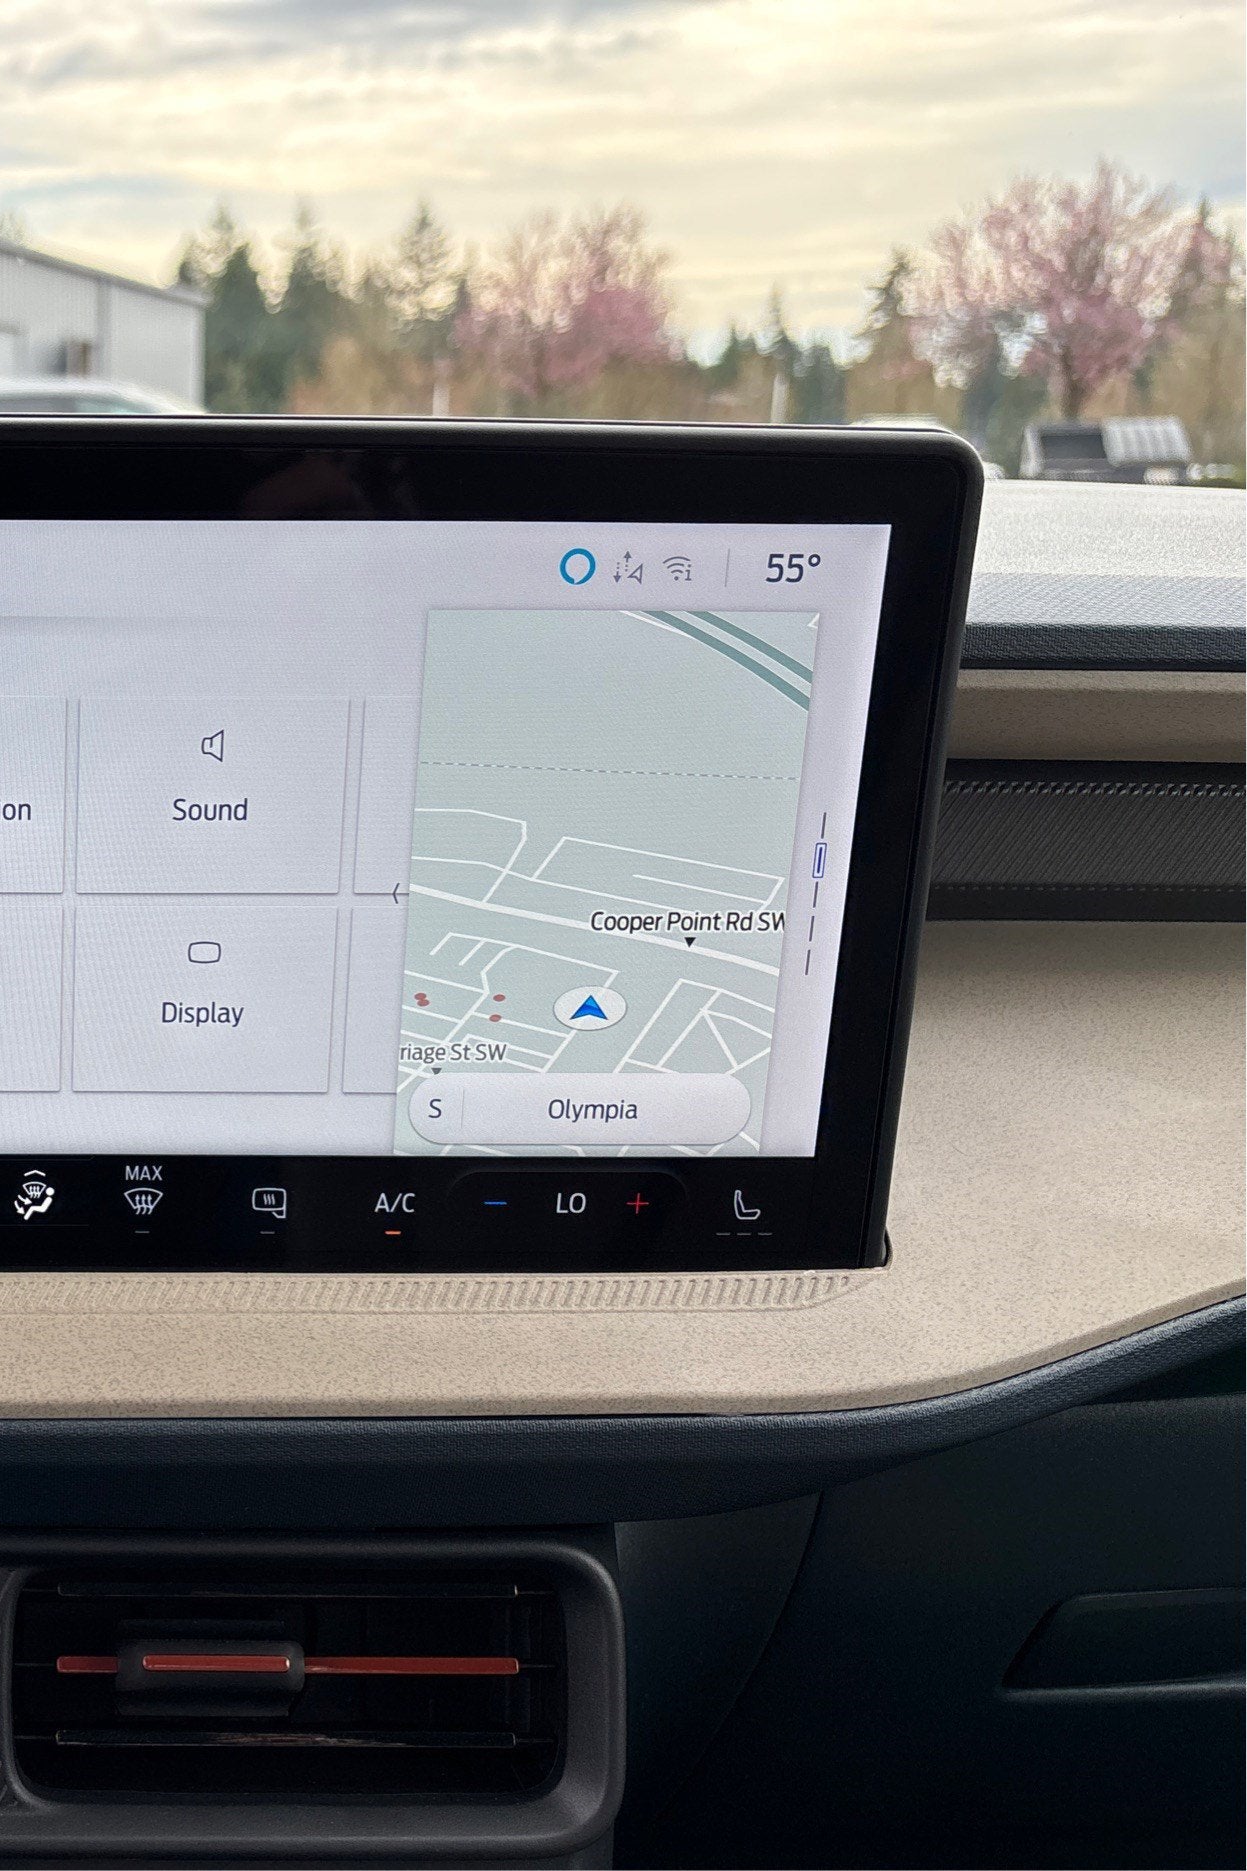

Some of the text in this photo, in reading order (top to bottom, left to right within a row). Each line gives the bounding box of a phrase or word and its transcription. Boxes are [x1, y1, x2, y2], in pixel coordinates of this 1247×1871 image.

[764, 552, 822, 583] 55°
[171, 797, 249, 822] Sound
[590, 911, 663, 935] Cooper
[666, 911, 724, 932] Point
[725, 911, 753, 932] Rd
[160, 1000, 245, 1028] Display
[449, 1044, 471, 1062] St
[474, 1044, 507, 1062] SW
[427, 1098, 442, 1119] S
[547, 1097, 639, 1124] Olympia
[124, 1165, 163, 1182] MAX
[373, 1192, 416, 1214] A/C
[555, 1192, 587, 1214] LO
